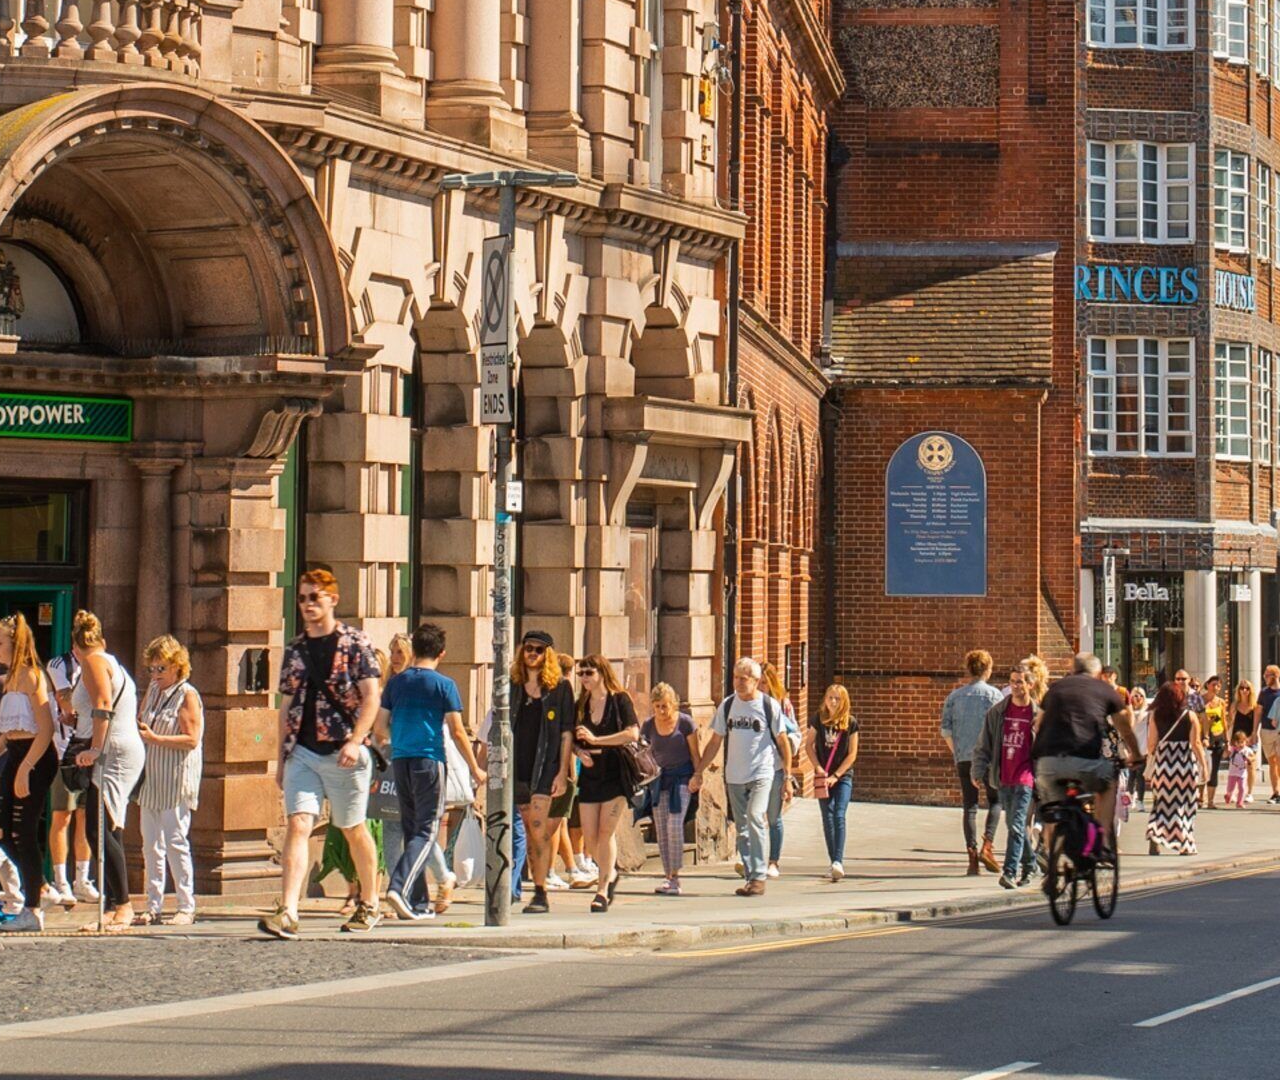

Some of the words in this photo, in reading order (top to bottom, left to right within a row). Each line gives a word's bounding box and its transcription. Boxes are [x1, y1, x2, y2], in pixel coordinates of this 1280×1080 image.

[1214, 269, 1256, 313] HOUSE
[482, 351, 506, 368] Restricted
[487, 370, 499, 385] Zone
[483, 393, 506, 415] ENDS
[1123, 582, 1170, 602] Bella
